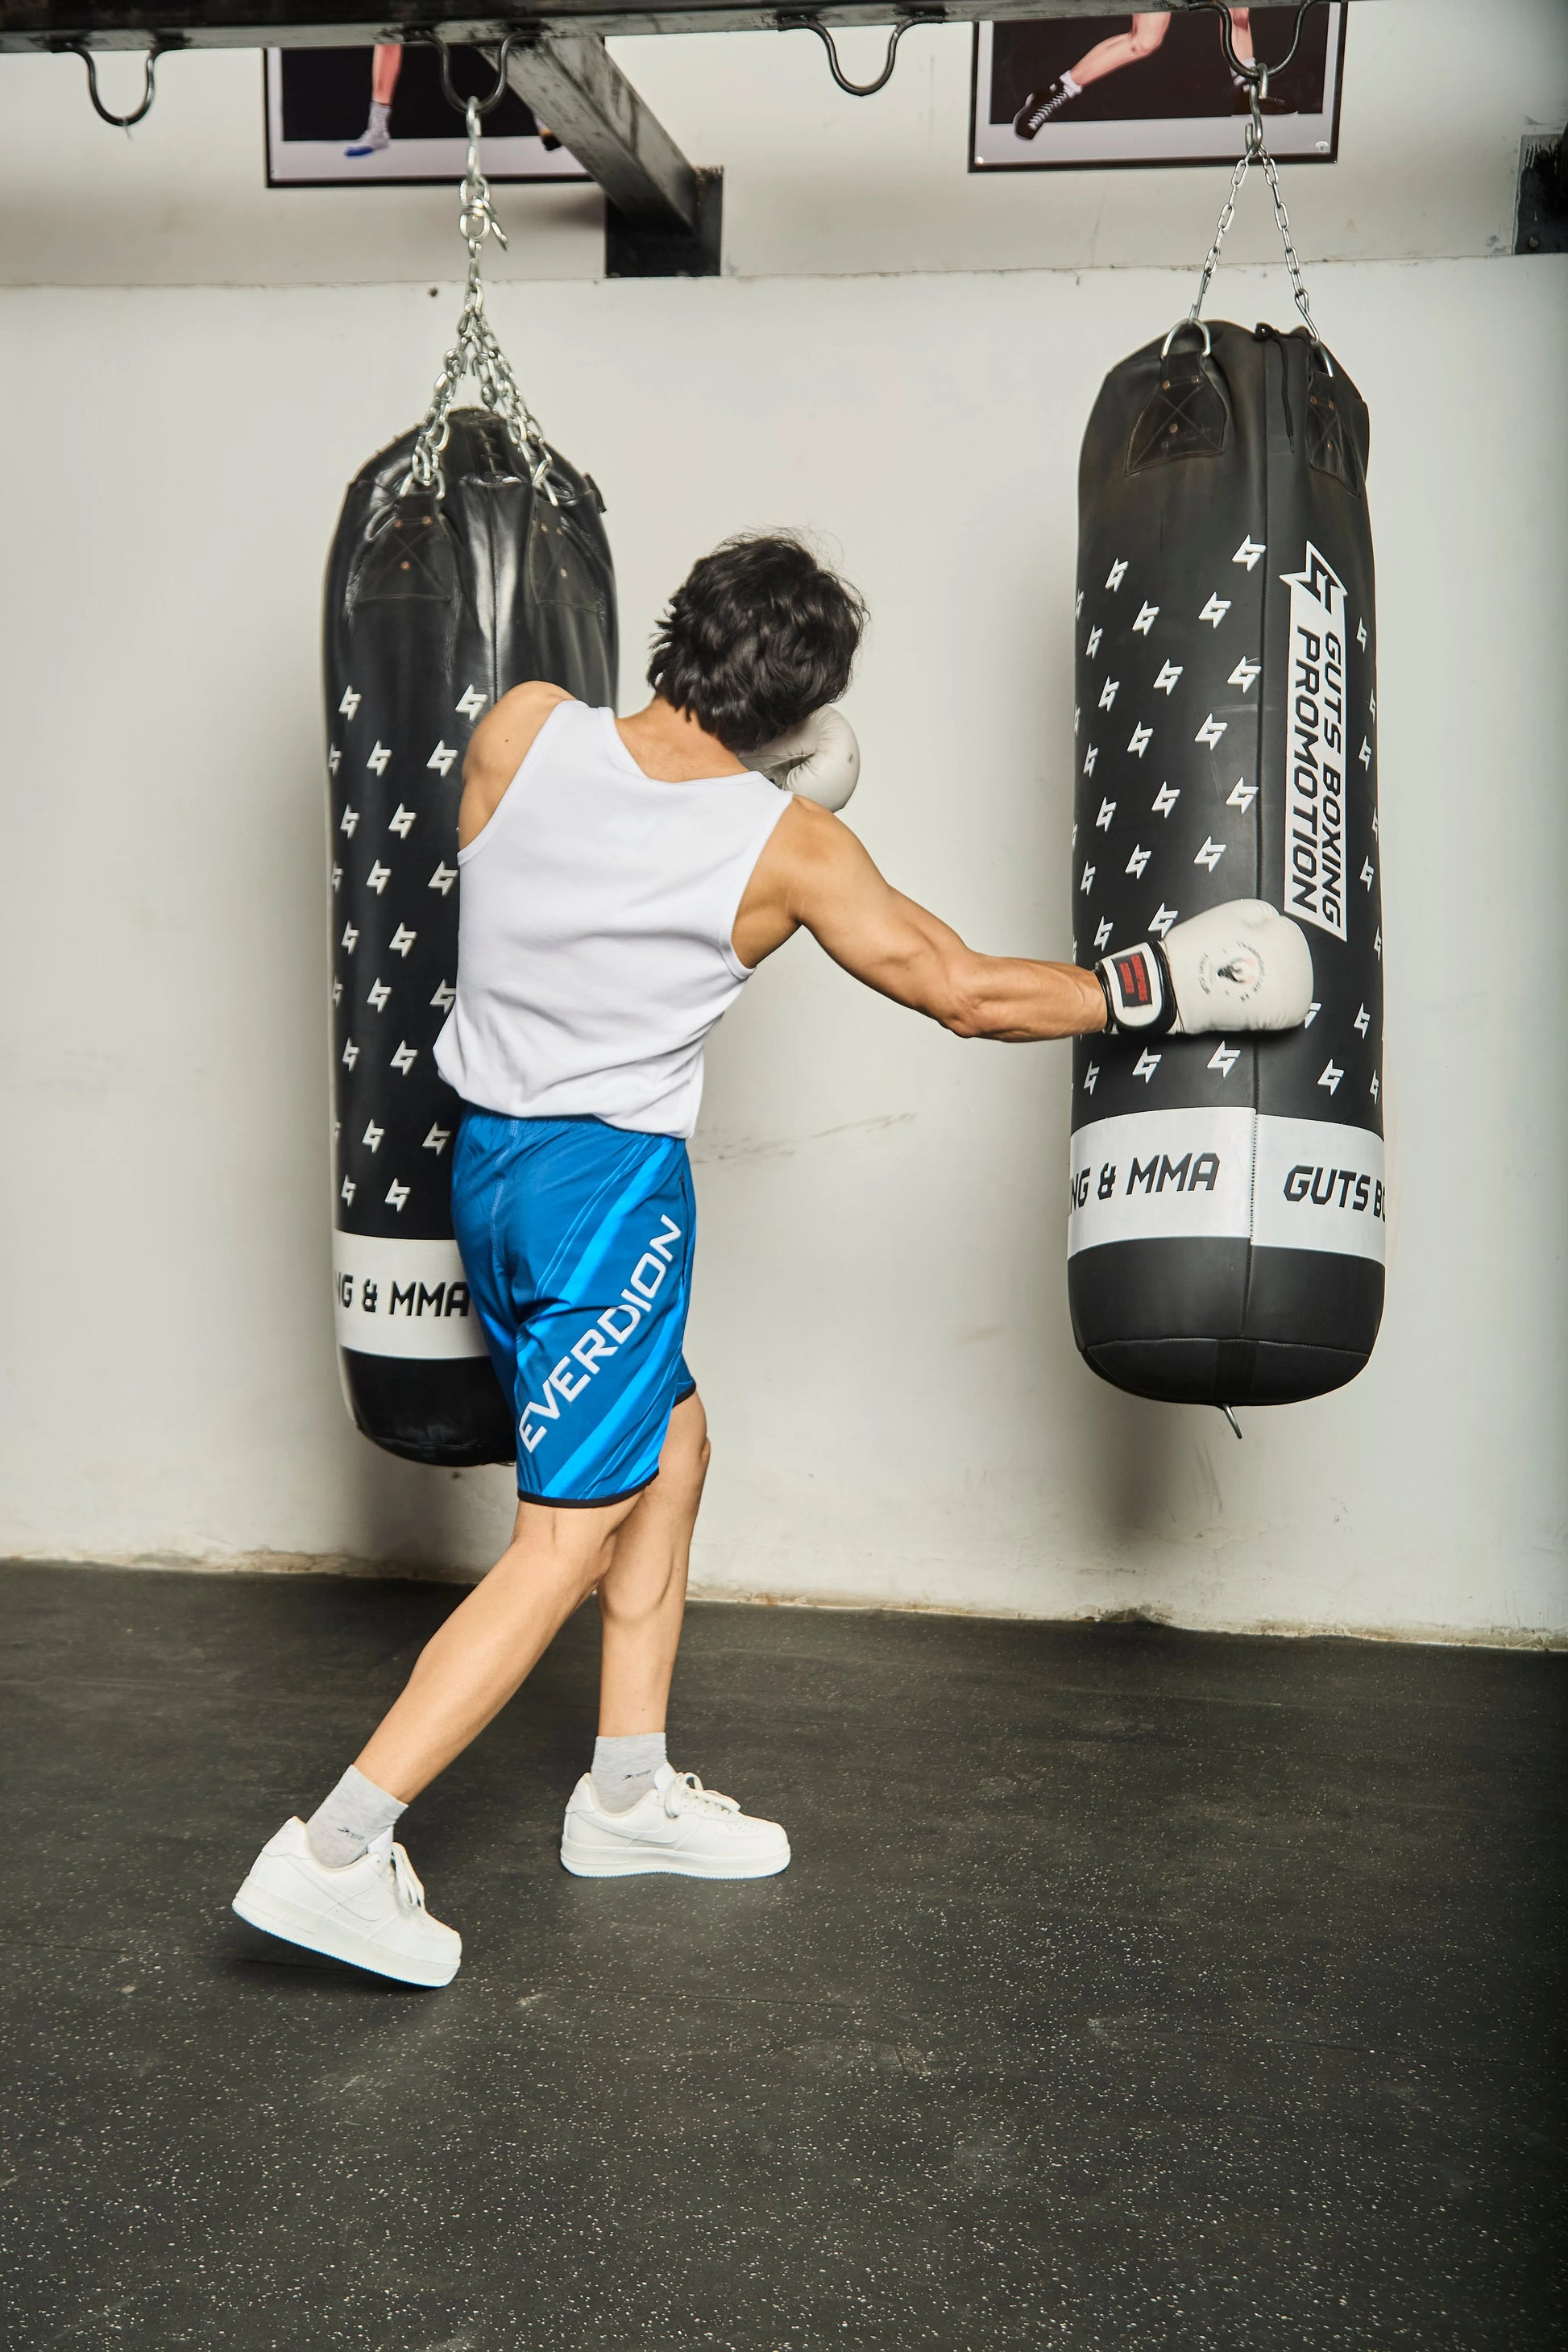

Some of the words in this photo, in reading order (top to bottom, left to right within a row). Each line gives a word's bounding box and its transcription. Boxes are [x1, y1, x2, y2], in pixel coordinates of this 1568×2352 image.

[1324, 630, 1342, 754] GUTS
[1292, 624, 1321, 914] PROMOTION
[1321, 762, 1342, 928] BOXING
[1097, 1162, 1117, 1201] &
[1126, 1151, 1221, 1196] MMA
[1283, 1164, 1371, 1212] GUTS
[362, 1278, 378, 1313] &
[388, 1280, 471, 1317] MMA
[518, 1214, 682, 1454] EVERDION
